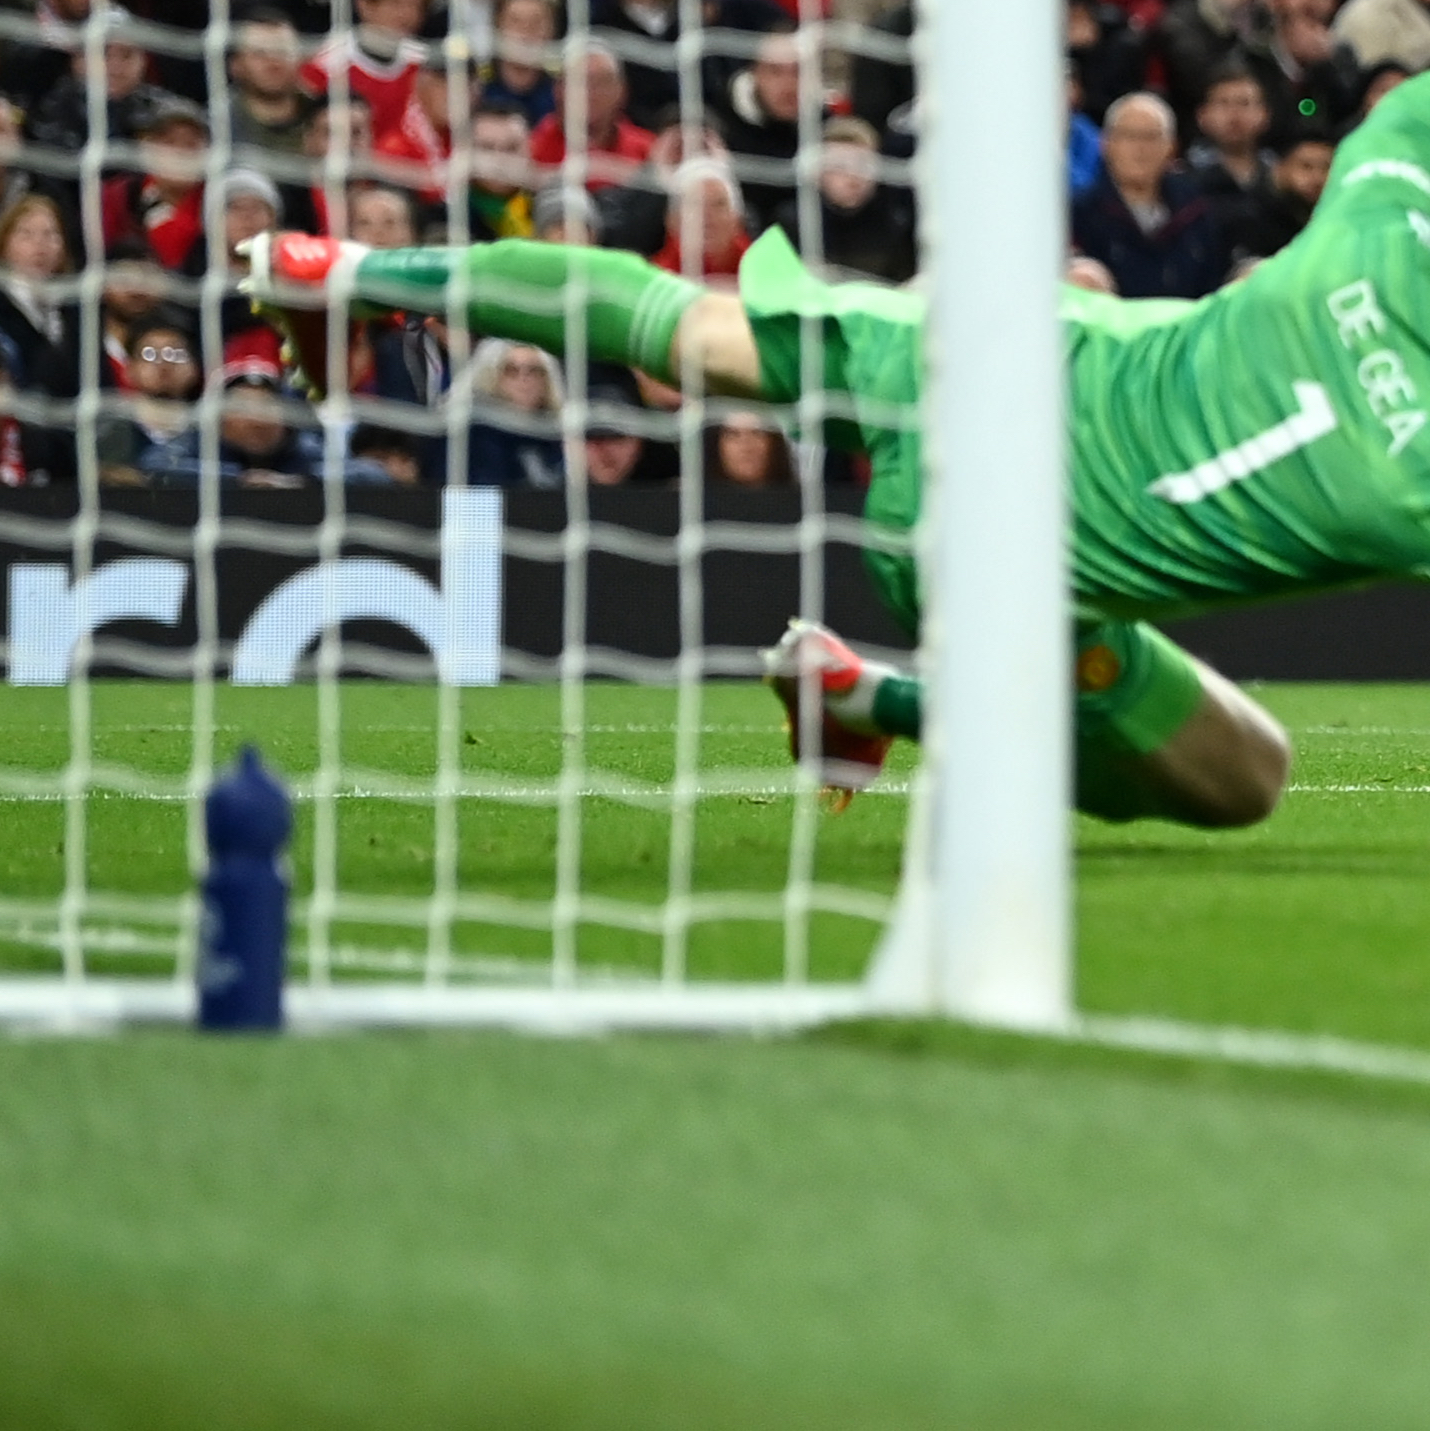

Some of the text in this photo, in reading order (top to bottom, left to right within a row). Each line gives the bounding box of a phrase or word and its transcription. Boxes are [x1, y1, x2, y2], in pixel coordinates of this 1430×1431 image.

[1145, 379, 1337, 504] 1
[1326, 278, 1427, 458] DE GEA
